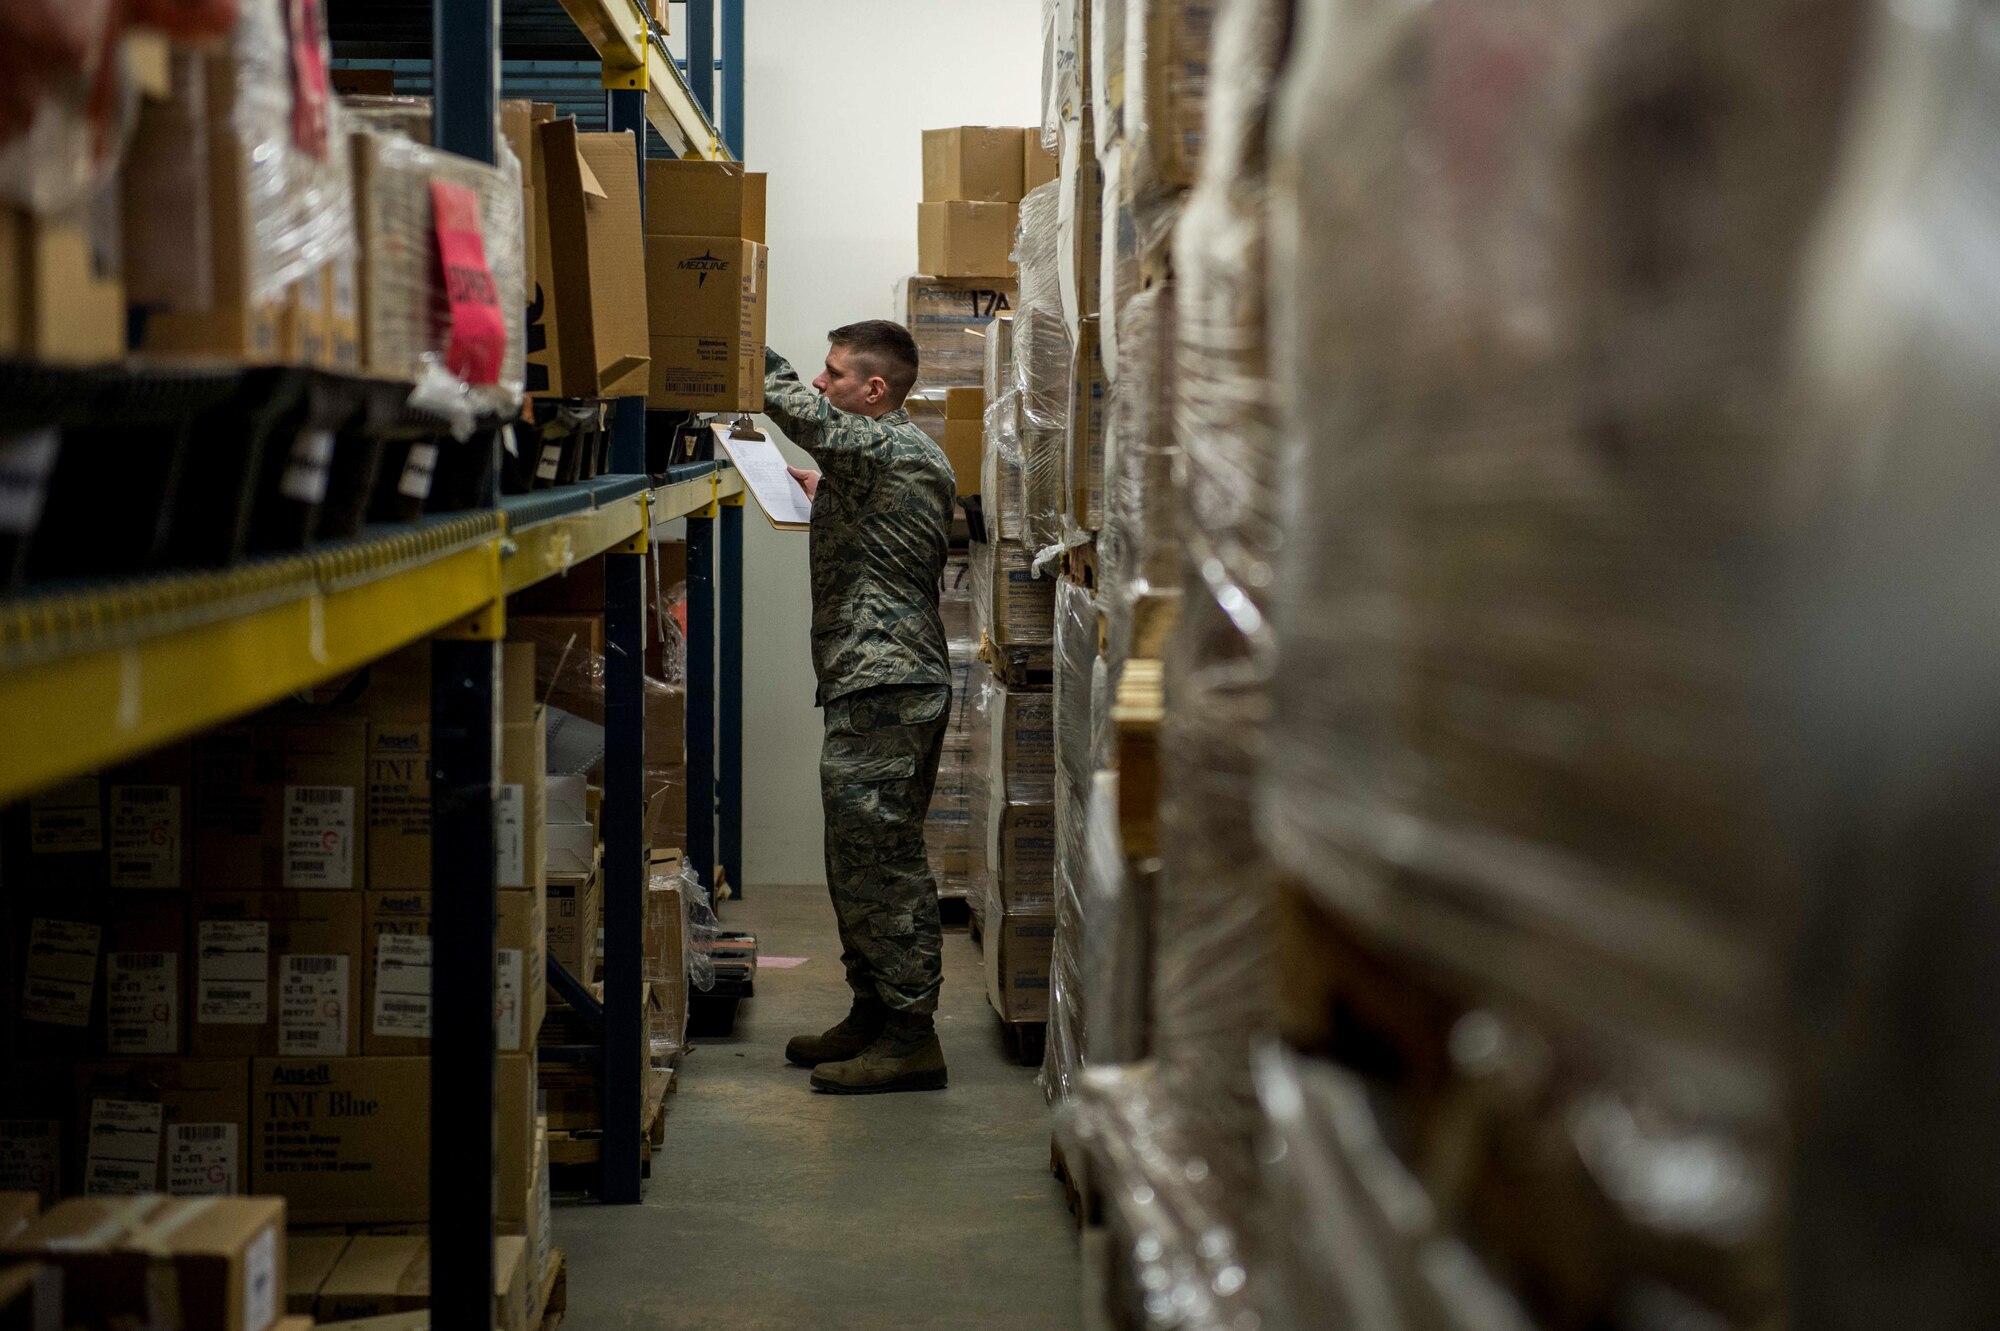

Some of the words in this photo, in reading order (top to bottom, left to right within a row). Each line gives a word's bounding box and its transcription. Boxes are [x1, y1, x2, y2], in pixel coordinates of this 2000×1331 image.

[677, 260, 730, 271] MEDLINE
[971, 289, 1011, 318] 17A
[372, 760, 417, 780] TNT
[272, 1064, 330, 1082] Ansell
[265, 1091, 318, 1117] TNT
[329, 1091, 379, 1117] Blue
[207, 1164, 226, 1184] G
